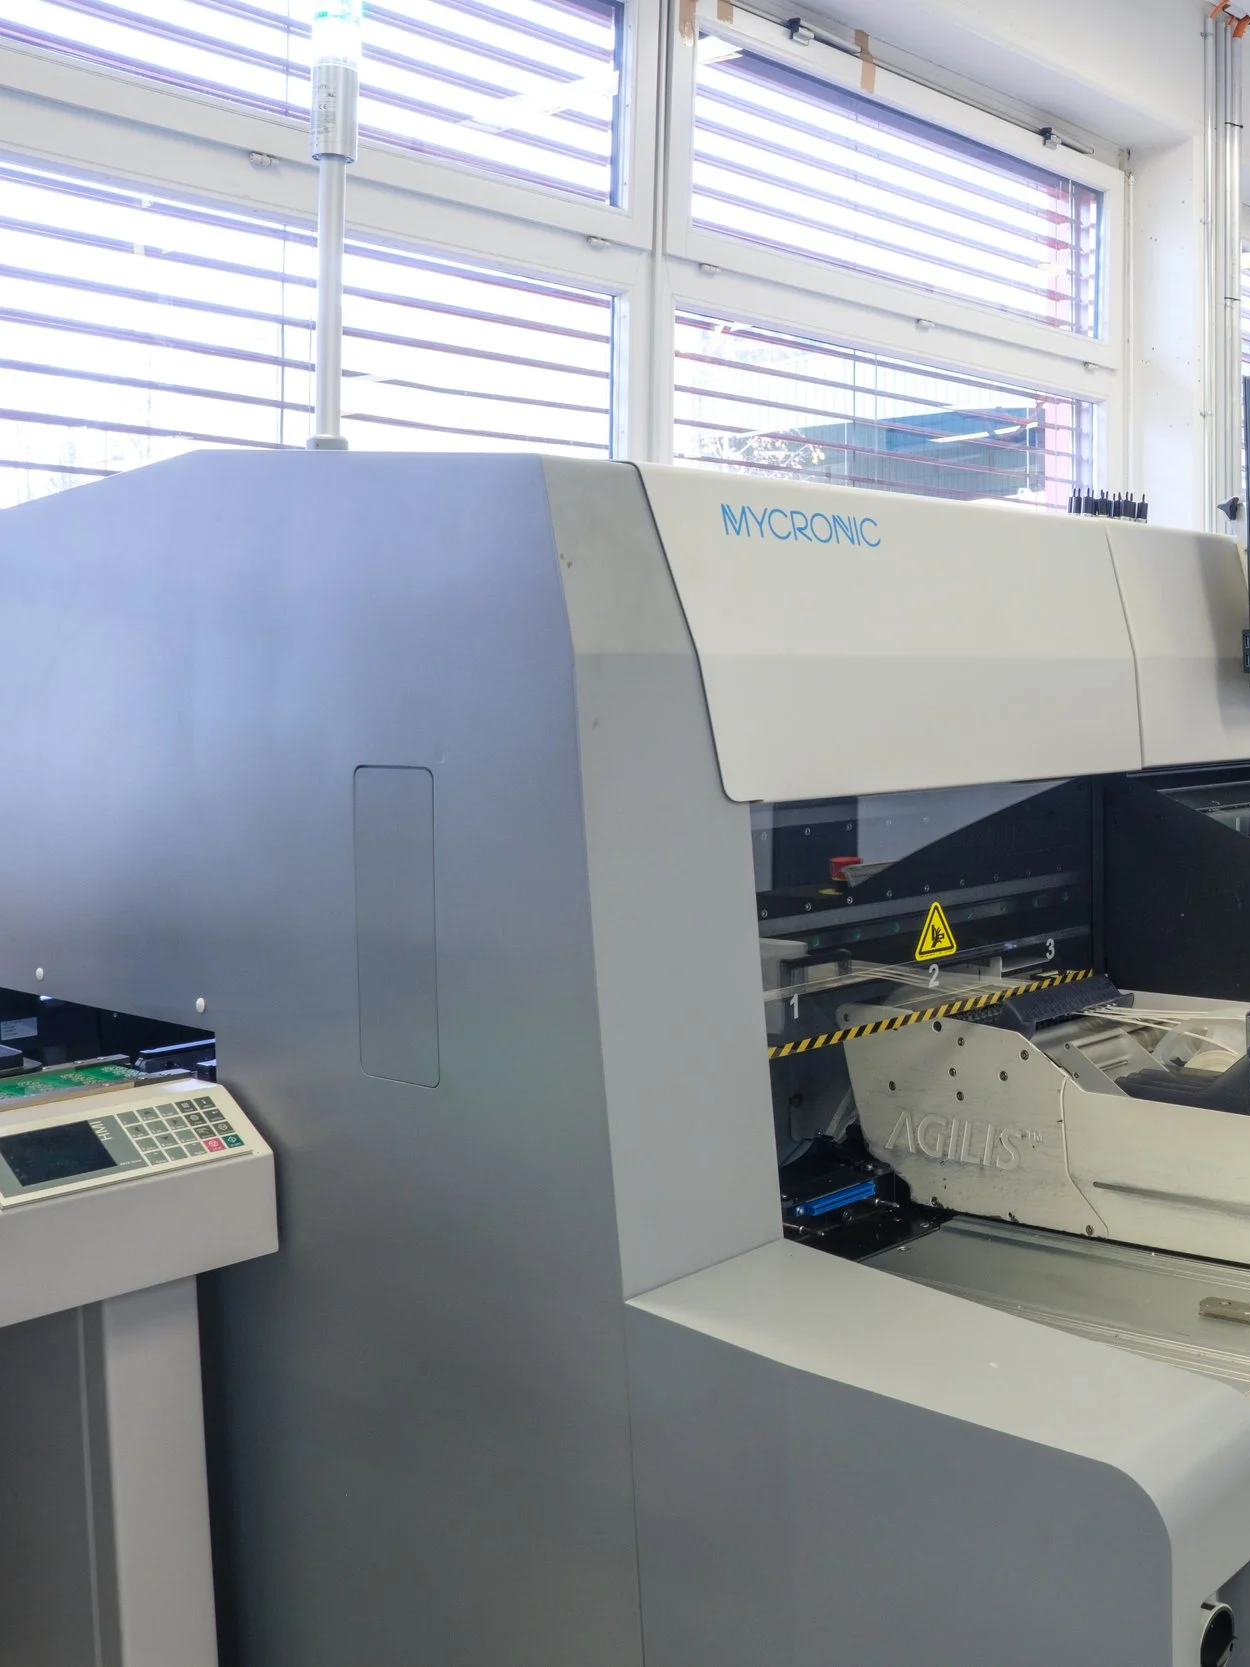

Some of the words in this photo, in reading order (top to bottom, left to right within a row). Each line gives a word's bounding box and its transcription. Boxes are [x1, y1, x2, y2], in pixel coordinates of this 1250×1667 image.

[720, 503, 881, 547] MYCRONIC
[1046, 938, 1055, 960] 3
[928, 963, 940, 988] 2
[789, 993, 799, 1019] 1
[90, 1120, 113, 1142] HMI
[885, 1110, 1021, 1171] AGILIS
